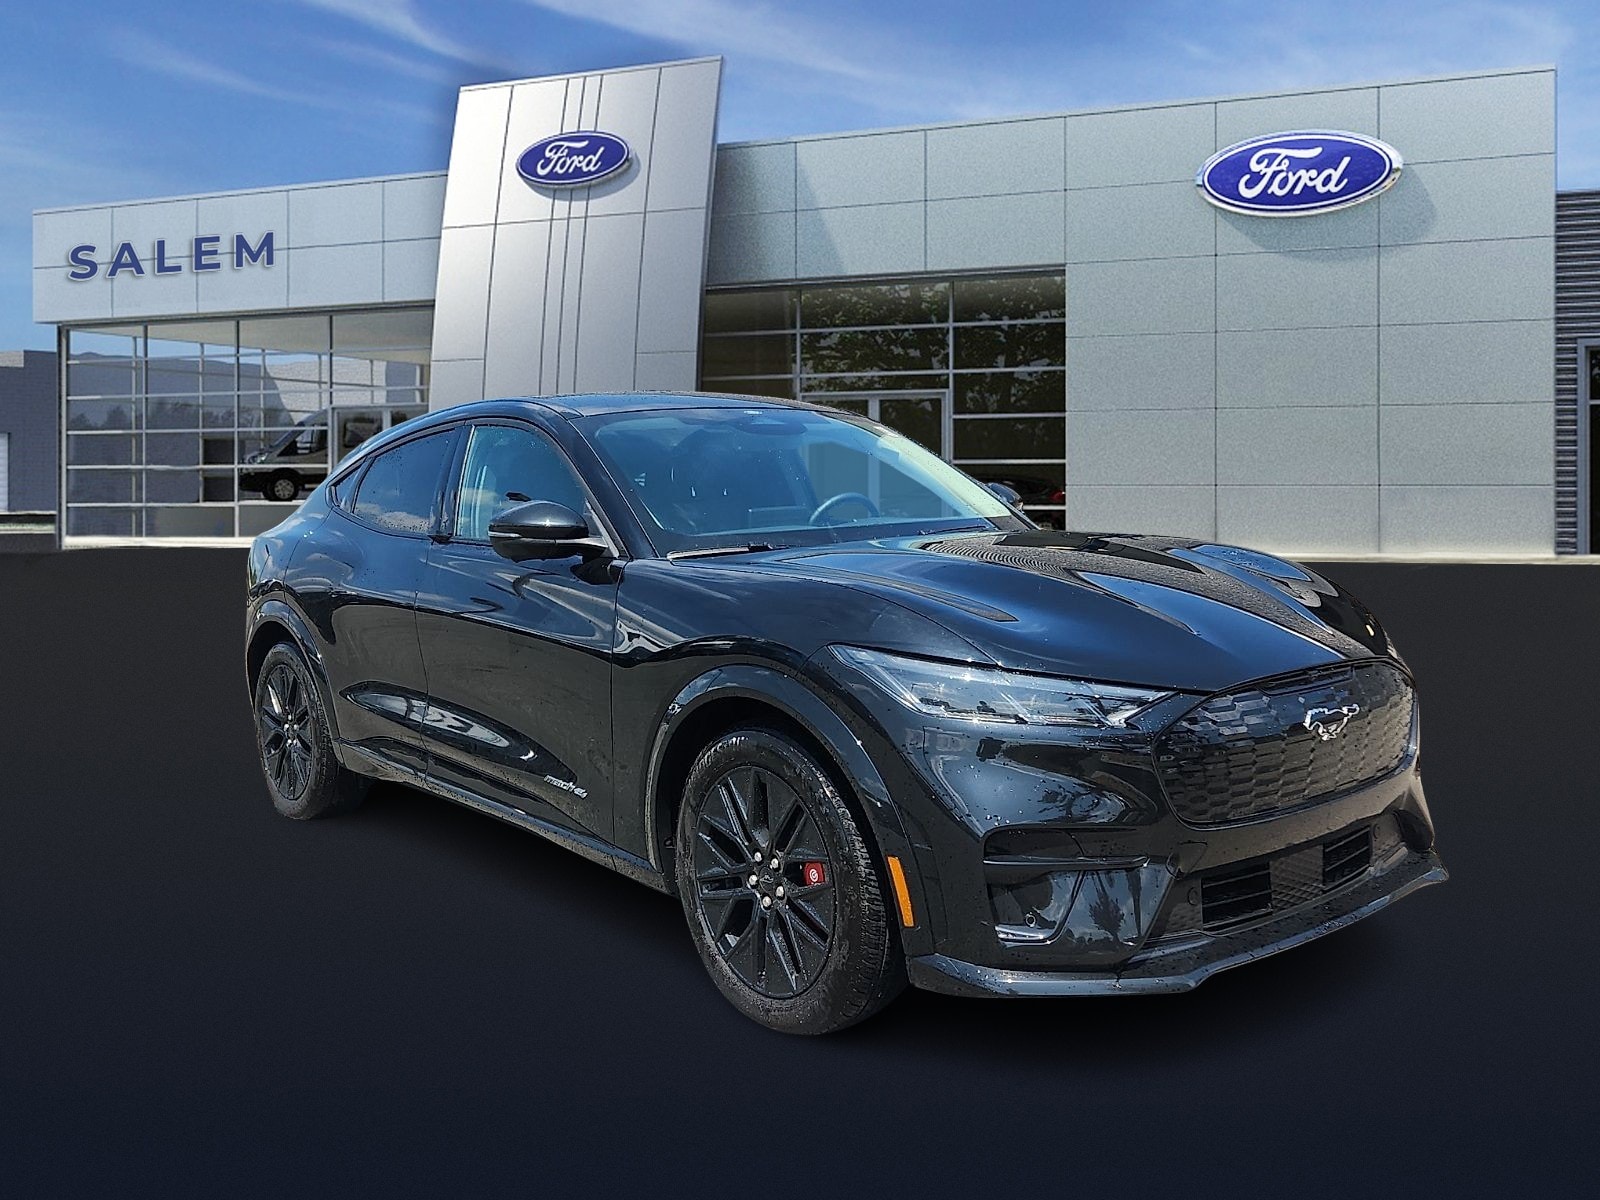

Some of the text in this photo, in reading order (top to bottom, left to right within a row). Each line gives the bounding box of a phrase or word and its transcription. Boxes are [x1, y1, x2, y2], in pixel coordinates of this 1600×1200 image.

[537, 140, 604, 175] Ford
[1238, 147, 1351, 198] Ford
[68, 231, 274, 280] SALEM
